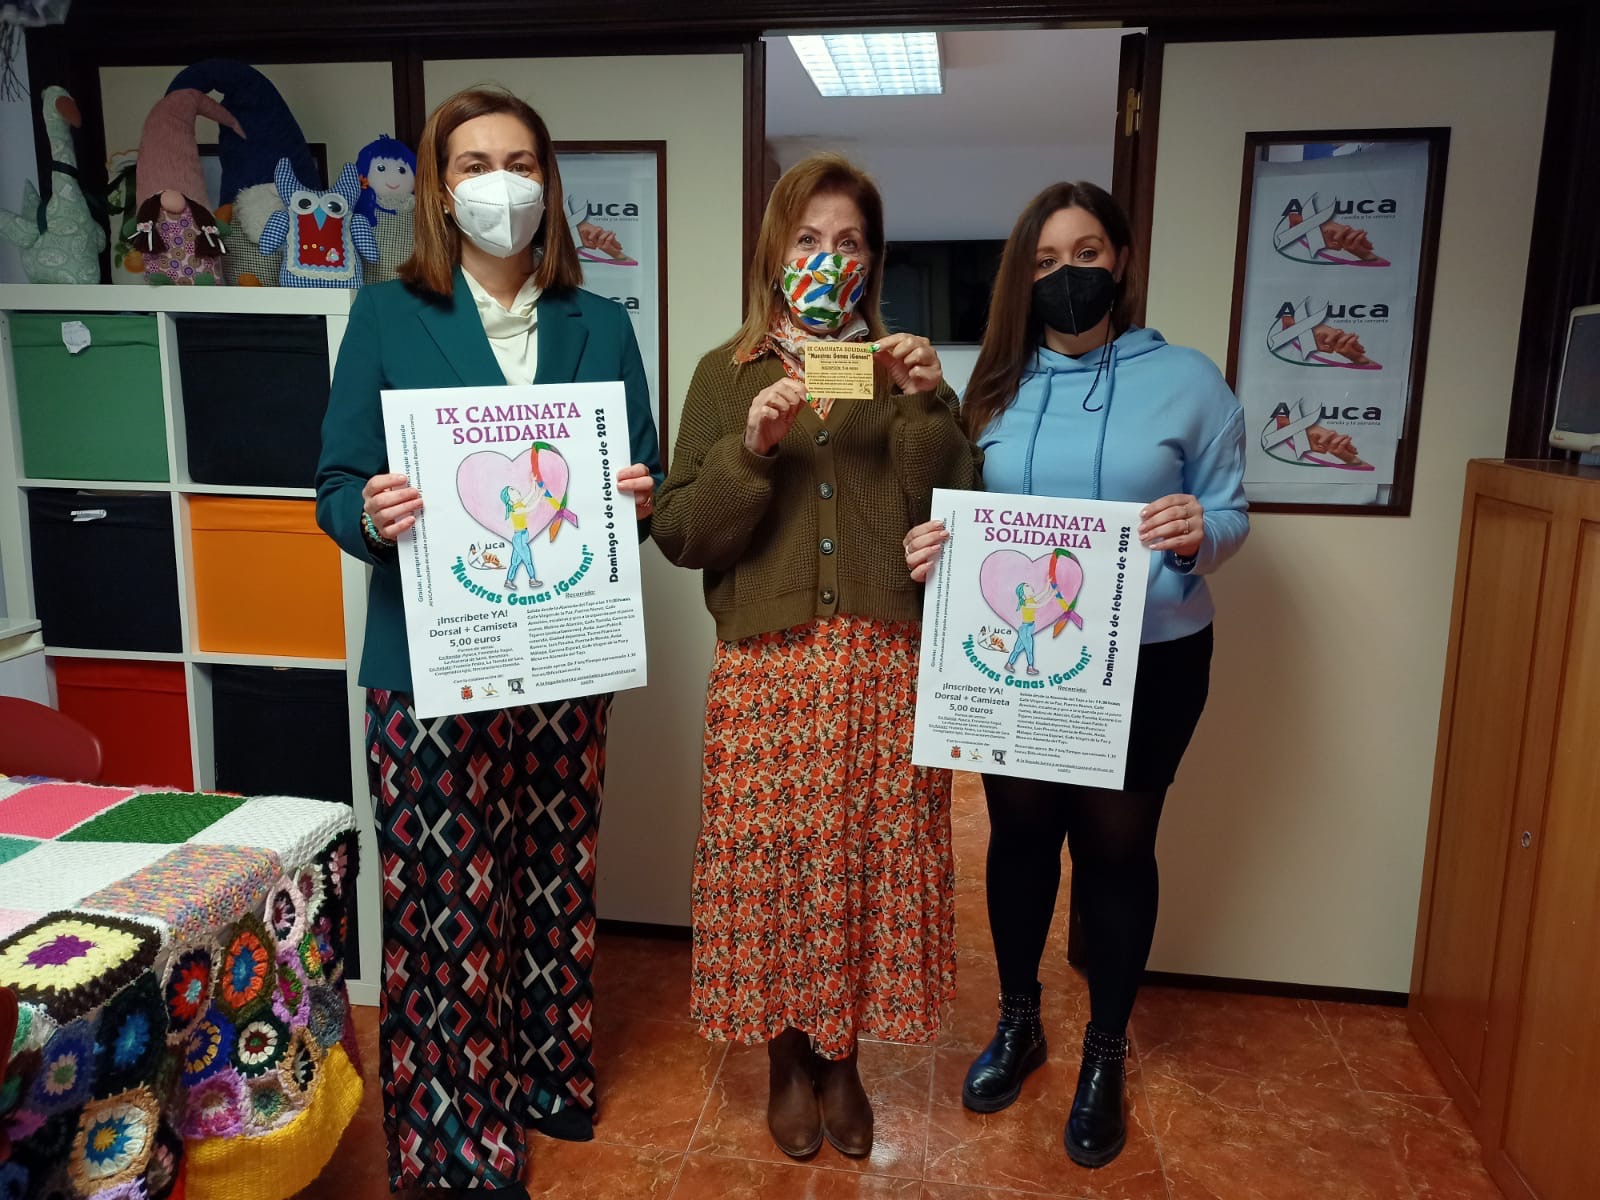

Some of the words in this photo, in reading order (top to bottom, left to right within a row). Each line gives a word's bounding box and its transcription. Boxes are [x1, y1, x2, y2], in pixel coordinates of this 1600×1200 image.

[436, 408, 459, 424] IX
[466, 402, 581, 423] CAMINATA
[594, 408, 606, 437] 2022
[453, 423, 570, 444] SOLIDARIA
[598, 441, 608, 455] de
[600, 458, 612, 501] febrero
[603, 504, 613, 519] de
[974, 509, 994, 523] IX
[1000, 510, 1106, 532] CAMINATA
[985, 527, 1092, 549] SOLIDARIA
[1117, 526, 1130, 553] 2022
[605, 532, 621, 582] Domingo
[1116, 556, 1126, 569] de
[451, 556, 502, 603] "Nuestras
[507, 591, 551, 605] Ganas
[1111, 572, 1124, 611] febrero
[491, 610, 508, 618] YA!
[1109, 614, 1119, 627] de
[430, 627, 461, 637] Dorsal
[473, 621, 517, 632] Camiseta
[450, 638, 472, 647] 5,00
[474, 635, 501, 644] euros
[962, 634, 1001, 681] "Nuestras
[1005, 675, 1044, 688] Ganas
[1102, 639, 1118, 686] Domingo
[935, 692, 961, 700] Dorsal
[971, 696, 1009, 706] Camiseta
[988, 687, 1003, 695] YA!
